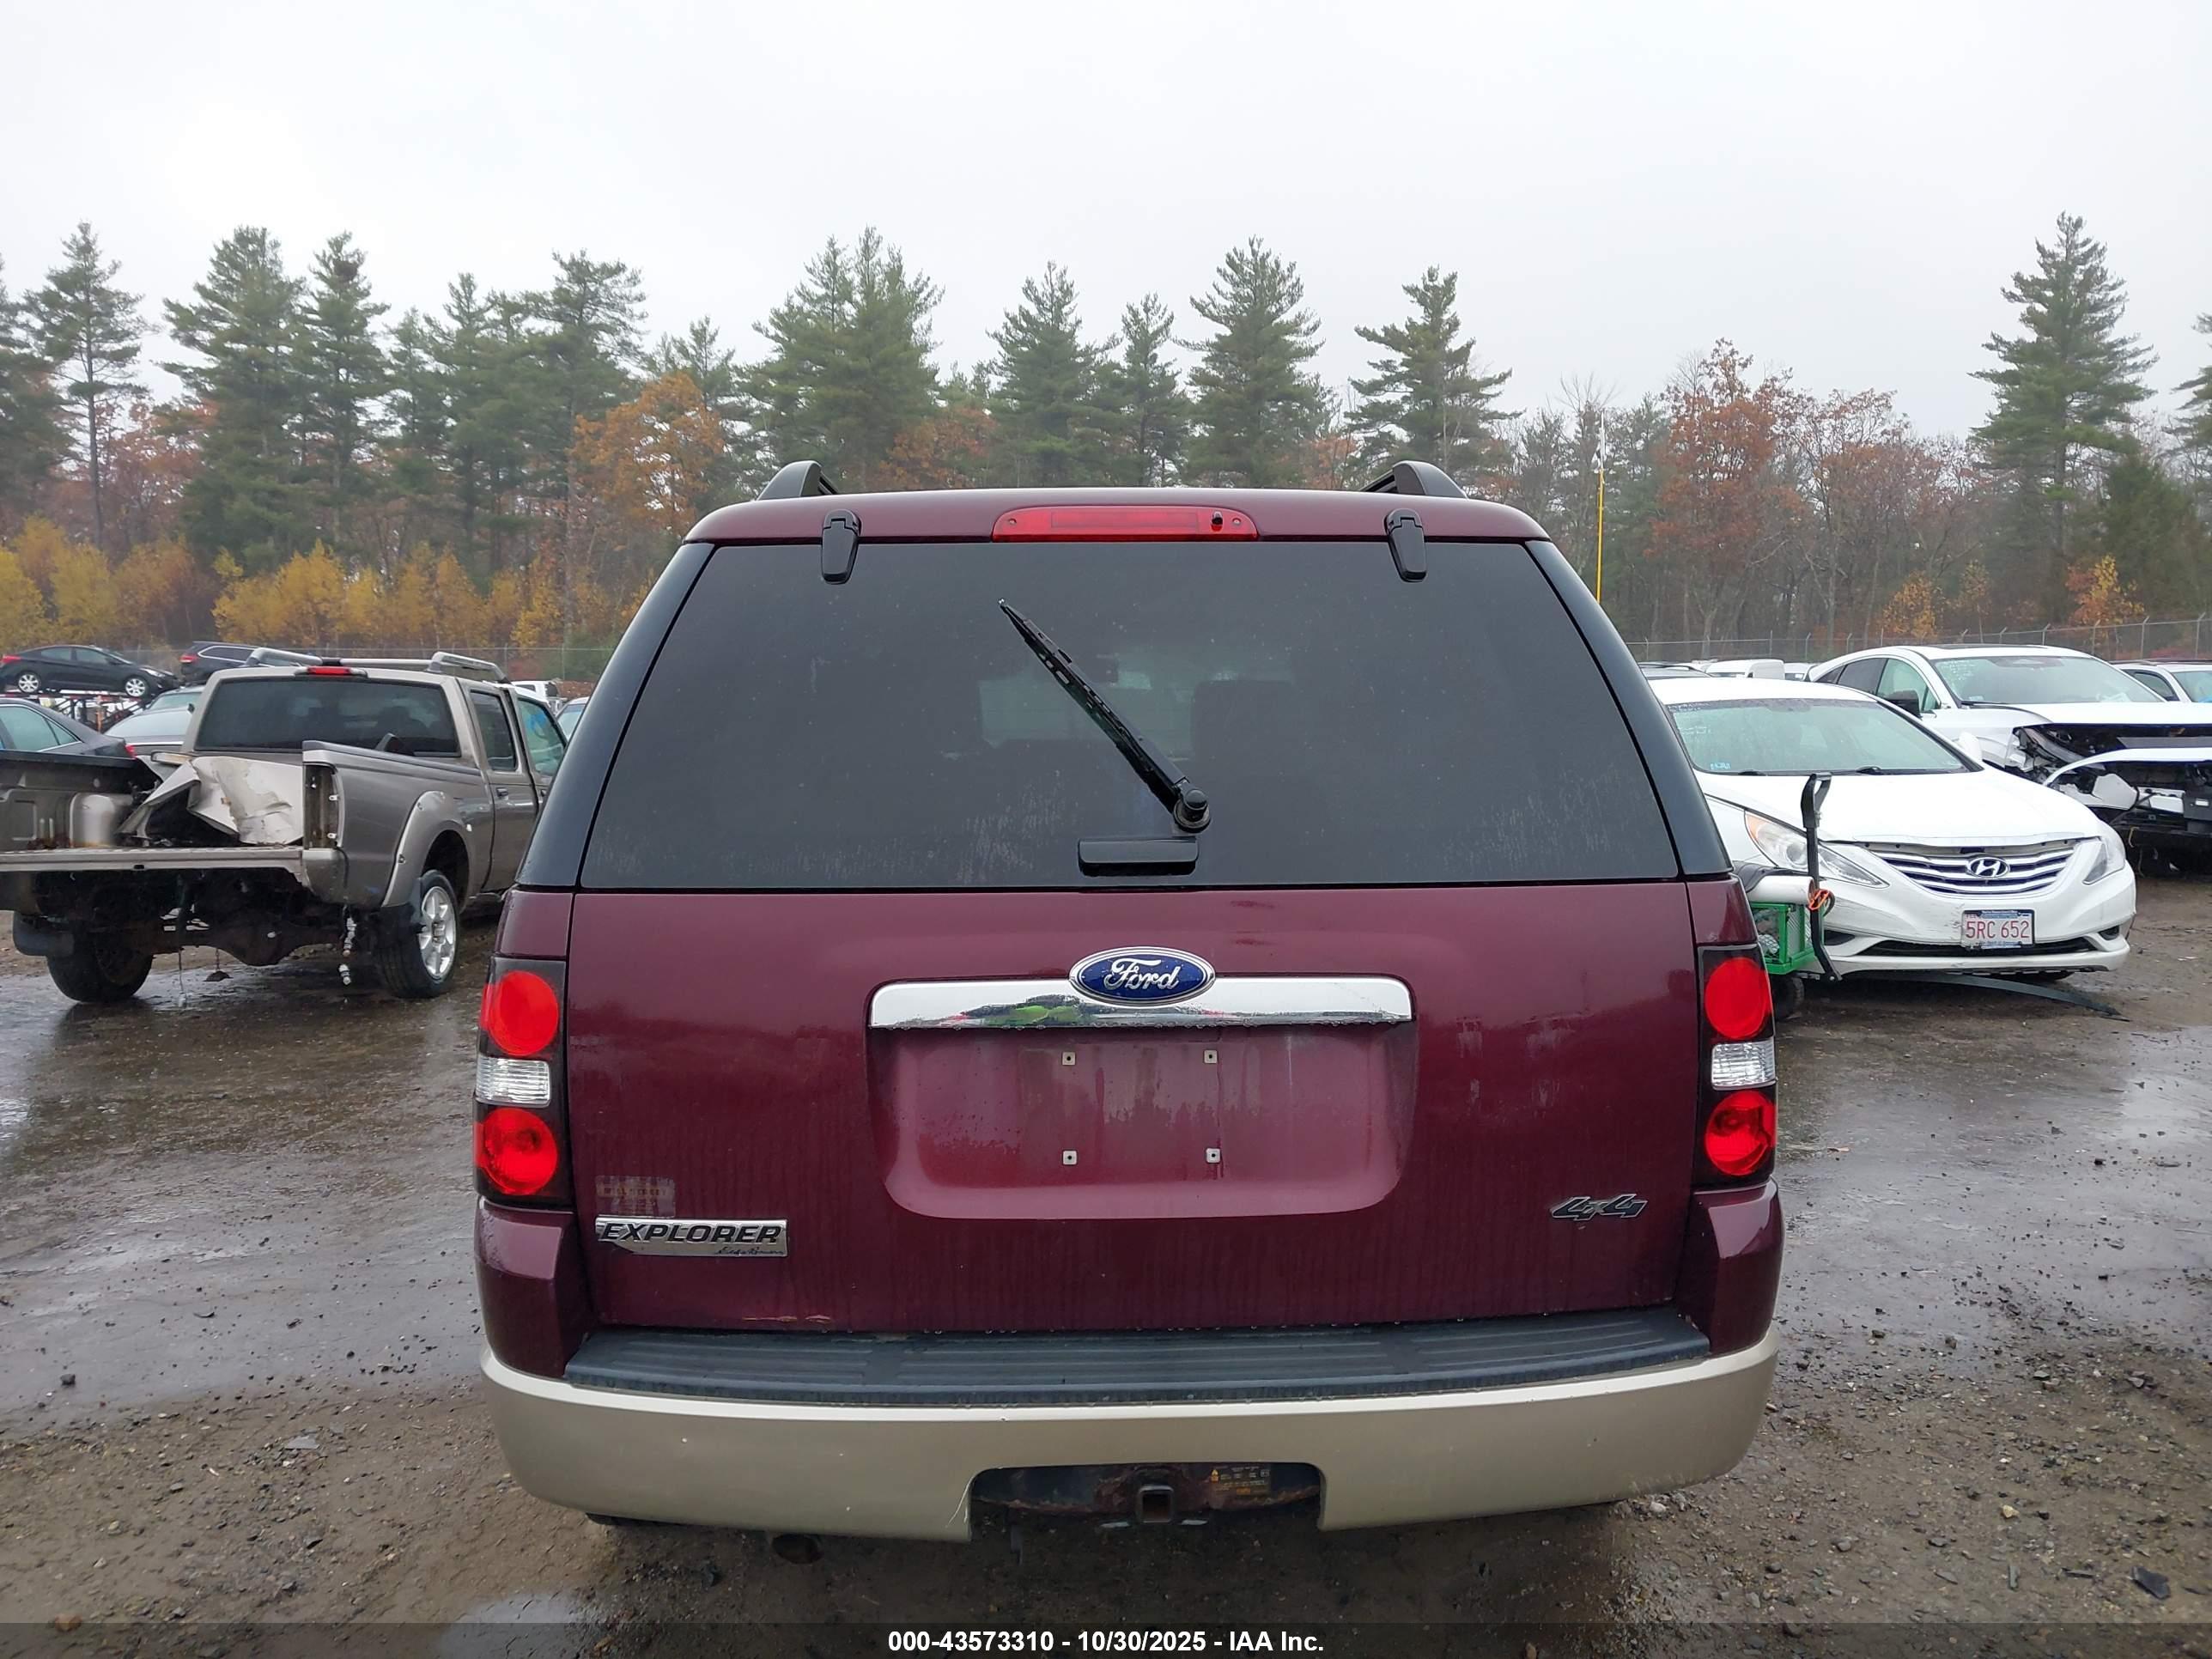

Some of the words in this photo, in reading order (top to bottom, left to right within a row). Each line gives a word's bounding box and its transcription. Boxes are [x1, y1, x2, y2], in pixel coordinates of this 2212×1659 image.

[1966, 921, 1996, 939] 5RC
[2001, 921, 2030, 939] 652
[1104, 958, 1181, 990] Ford
[603, 1223, 782, 1243] EXPLORER
